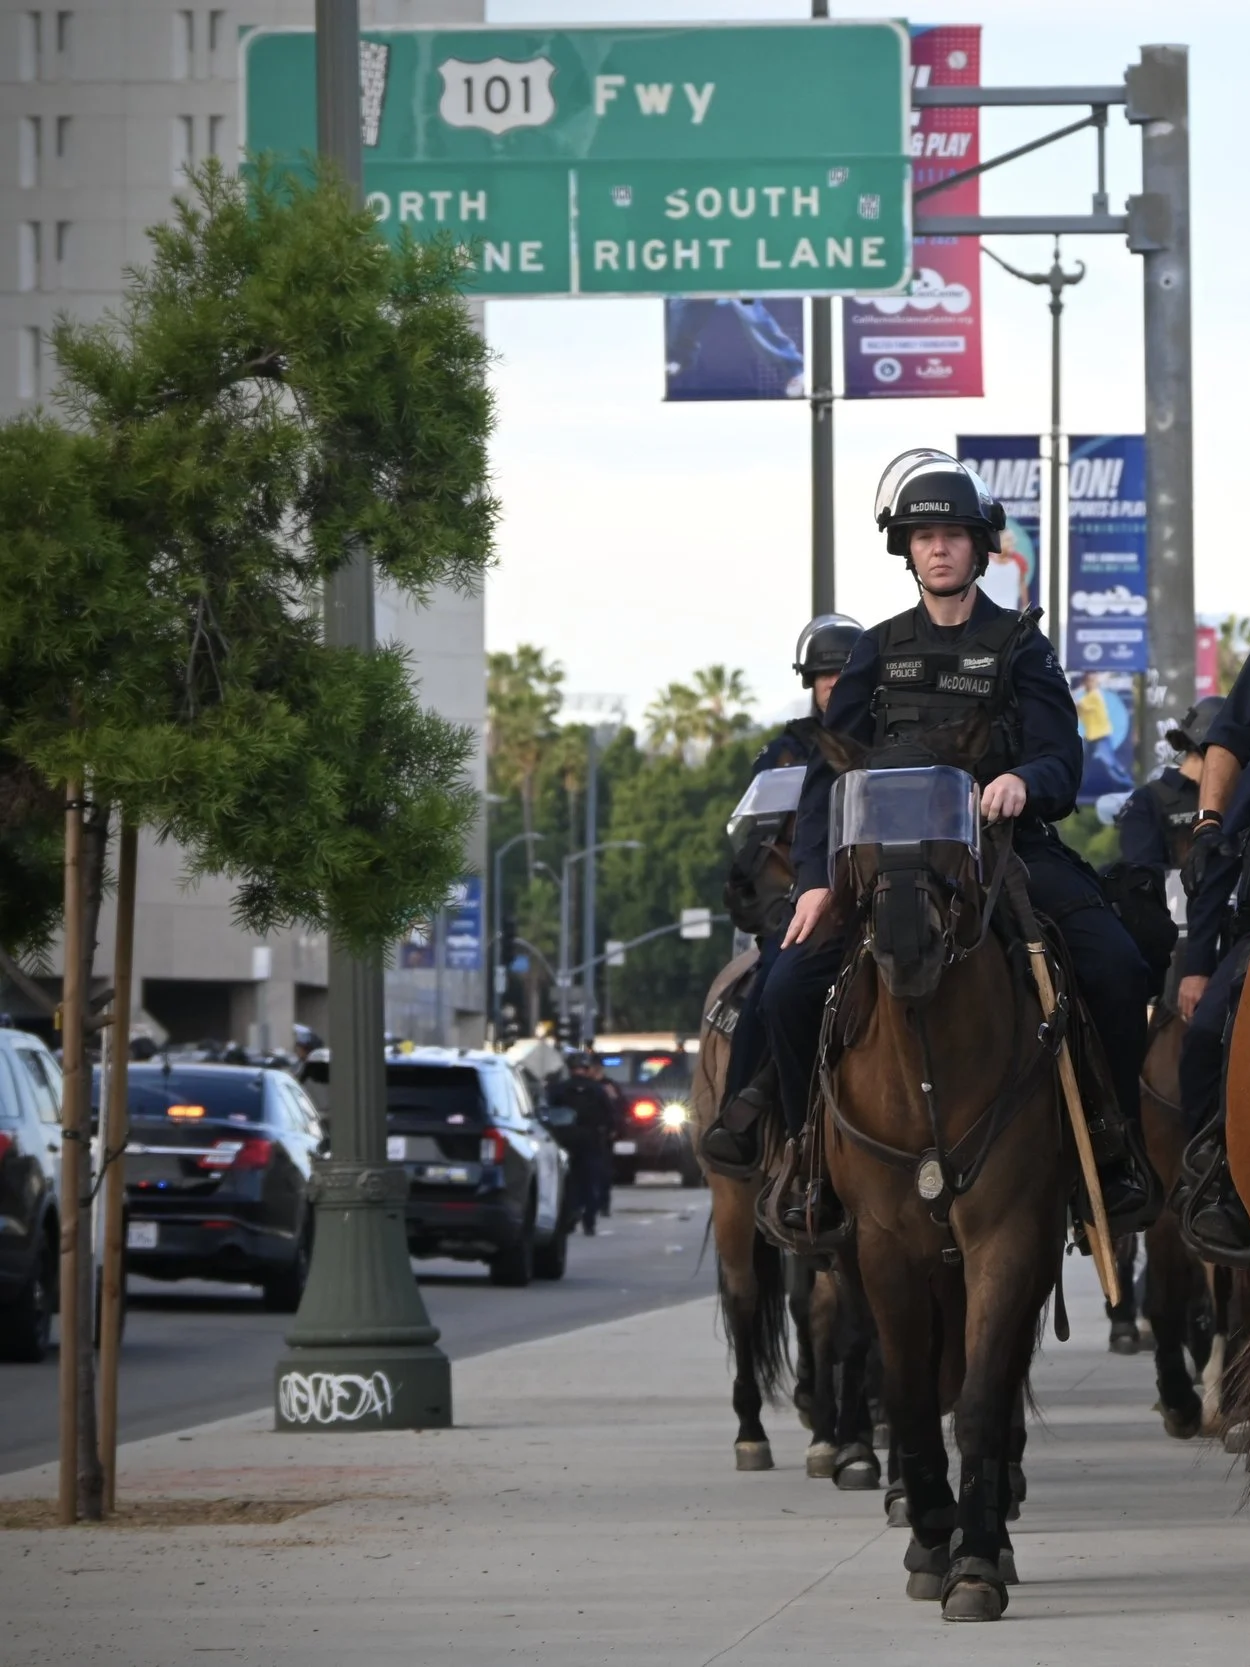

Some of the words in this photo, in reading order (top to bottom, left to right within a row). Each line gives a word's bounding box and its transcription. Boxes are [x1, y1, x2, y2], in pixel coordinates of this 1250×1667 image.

[464, 75, 531, 114] 101
[595, 74, 716, 124] Fwy
[925, 132, 972, 157] PLAY
[365, 190, 487, 222] ORTH
[664, 186, 820, 219] SOUTH
[593, 239, 731, 271] RIGHT
[756, 237, 887, 269] LANE
[1069, 458, 1124, 499] ON!
[910, 502, 950, 513] McDONALD
[890, 668, 917, 678] POLICE
[898, 660, 922, 669] ANGELES
[940, 674, 991, 694] McDONALD
